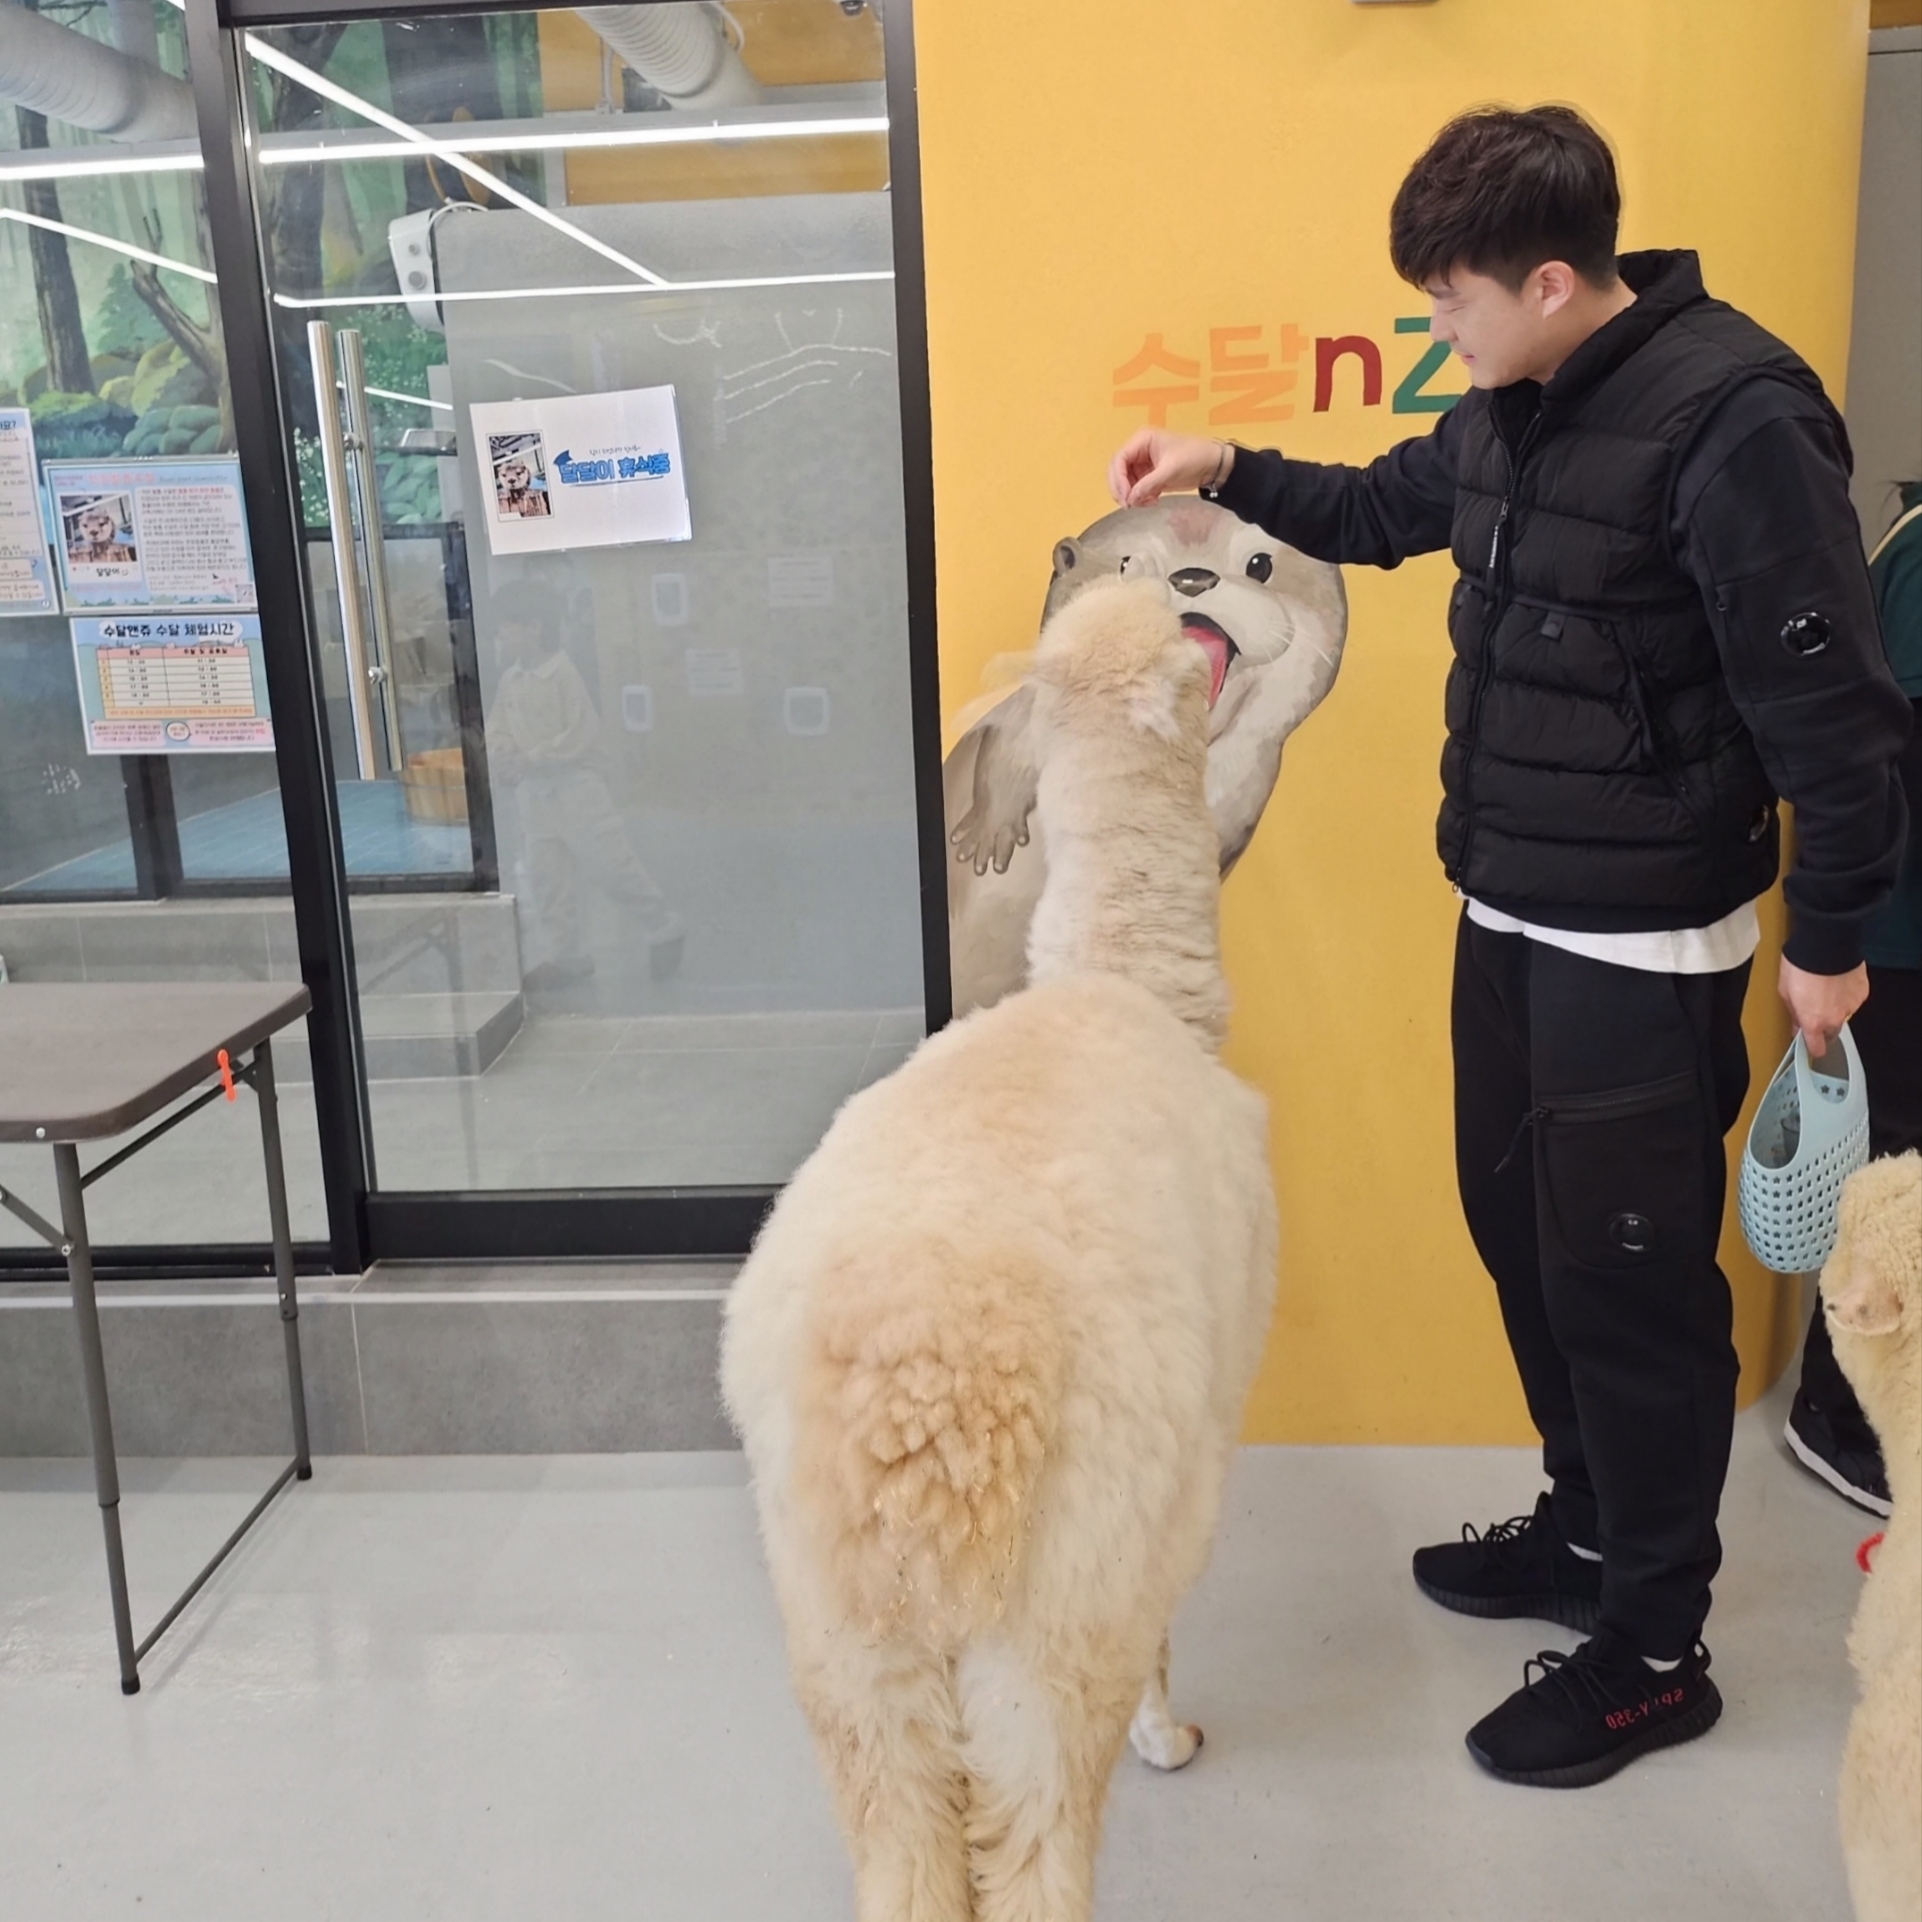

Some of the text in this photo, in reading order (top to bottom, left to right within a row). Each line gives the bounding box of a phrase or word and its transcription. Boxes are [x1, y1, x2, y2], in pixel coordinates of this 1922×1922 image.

[559, 453, 670, 484] 달달이 휴식중
[156, 623, 180, 637] 수달
[184, 622, 235, 636] 체험시간
